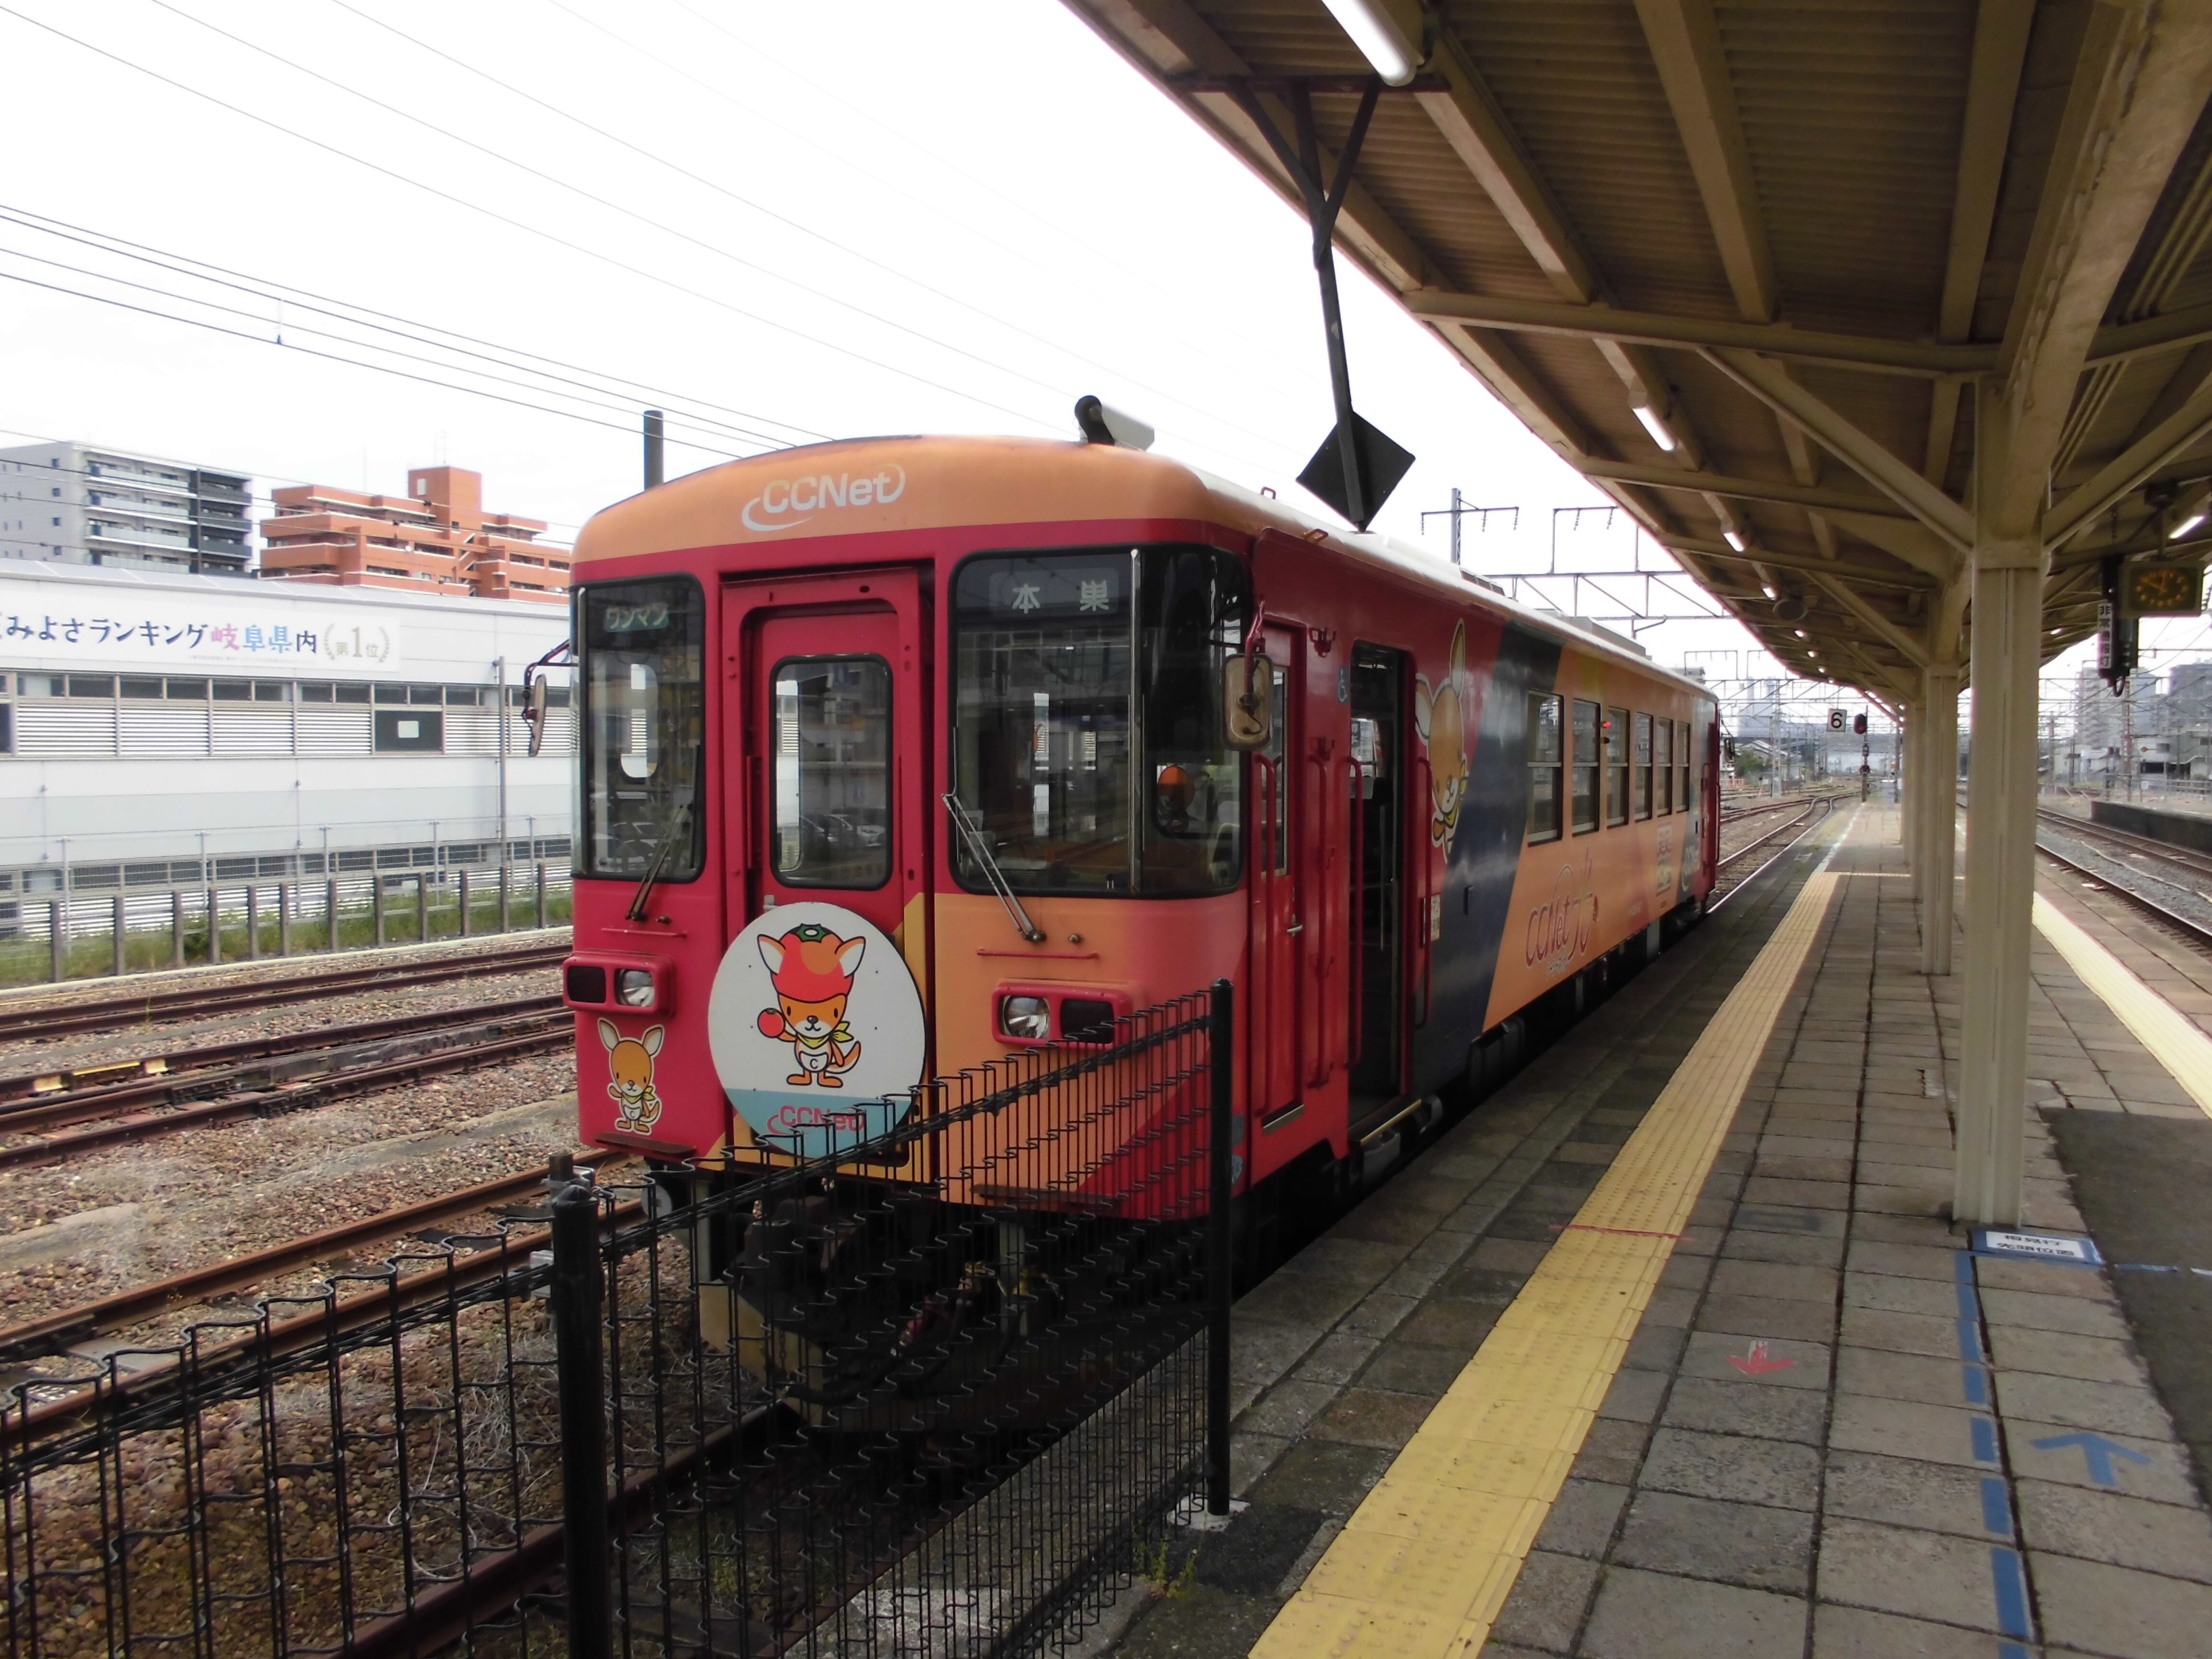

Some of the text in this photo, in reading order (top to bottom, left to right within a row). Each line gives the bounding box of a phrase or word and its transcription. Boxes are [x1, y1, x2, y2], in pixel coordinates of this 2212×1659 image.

[763, 466, 905, 514] CCNet
[1011, 579, 1110, 614] 本巣
[606, 604, 667, 629] ワンマン
[1830, 711, 1842, 729] 6
[810, 1058, 818, 1070] C
